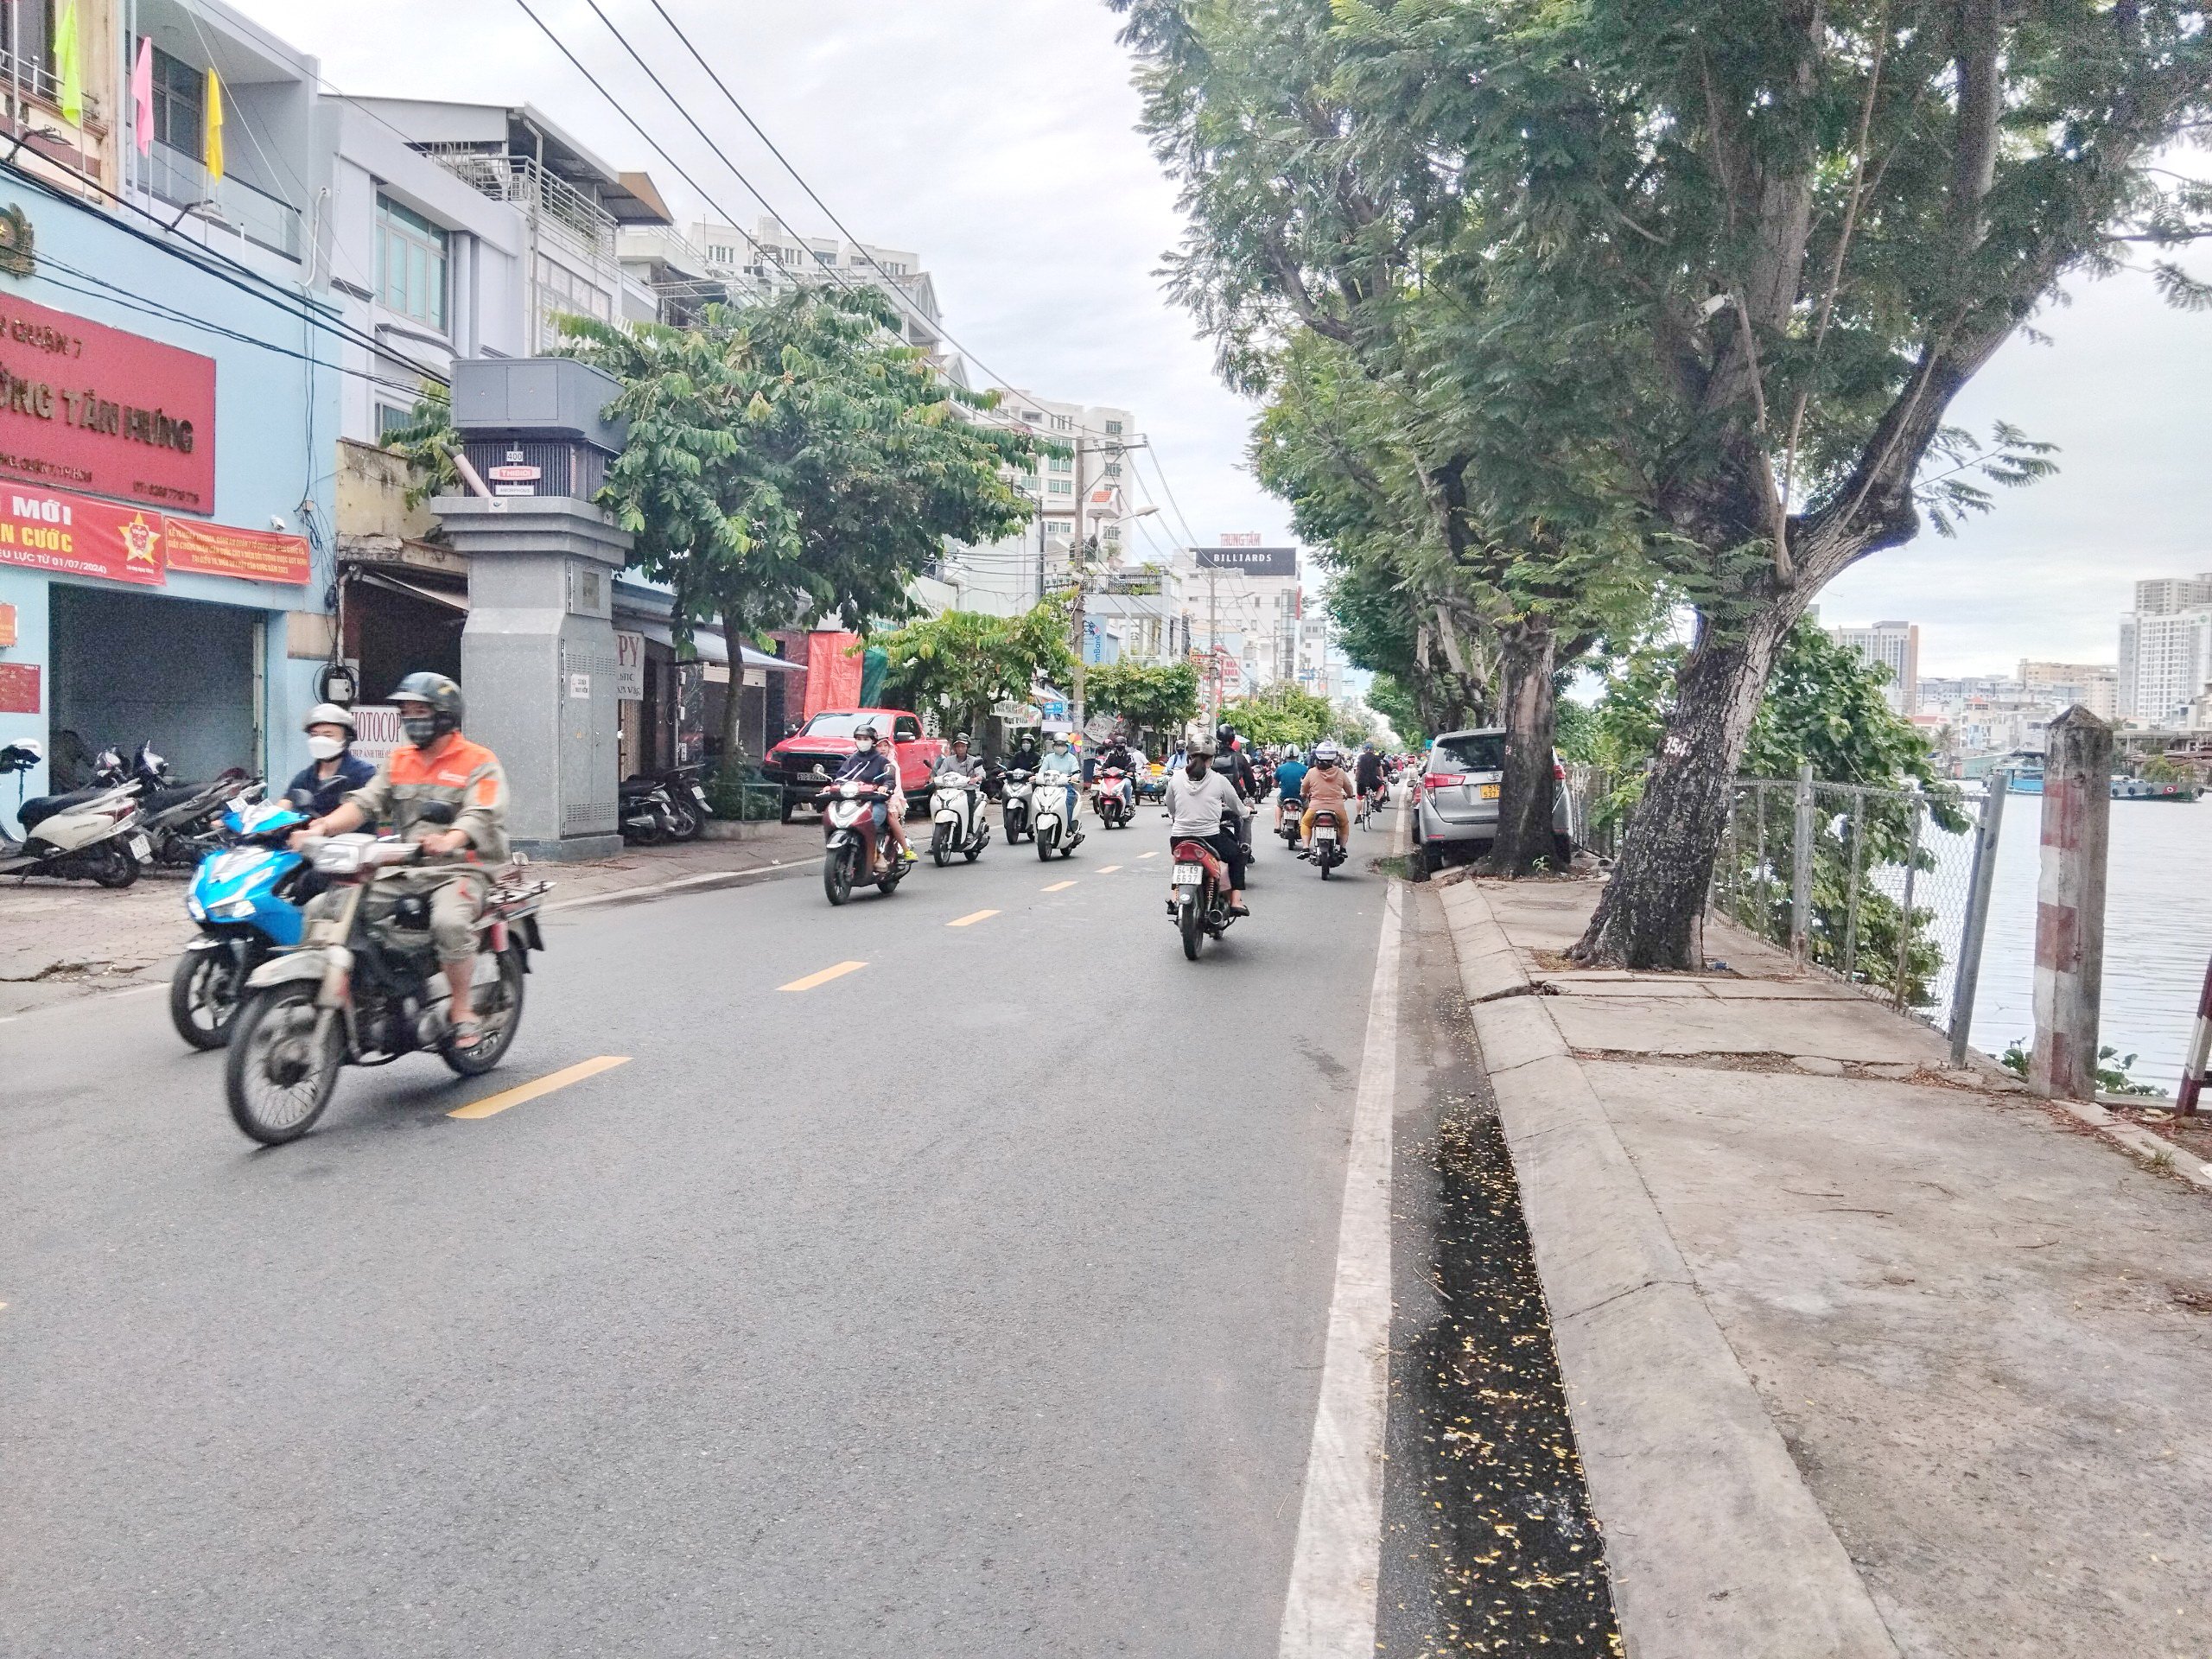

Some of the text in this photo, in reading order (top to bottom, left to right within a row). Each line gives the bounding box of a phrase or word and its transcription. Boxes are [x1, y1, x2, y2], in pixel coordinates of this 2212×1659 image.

[73, 338, 82, 359] 7
[62, 388, 119, 436] TÂN
[12, 494, 73, 526] MỚI
[22, 524, 73, 554] CƯỚC
[14, 550, 35, 563] LỰC
[36, 553, 50, 564] TỪ
[52, 556, 107, 575] 01/07/2024)
